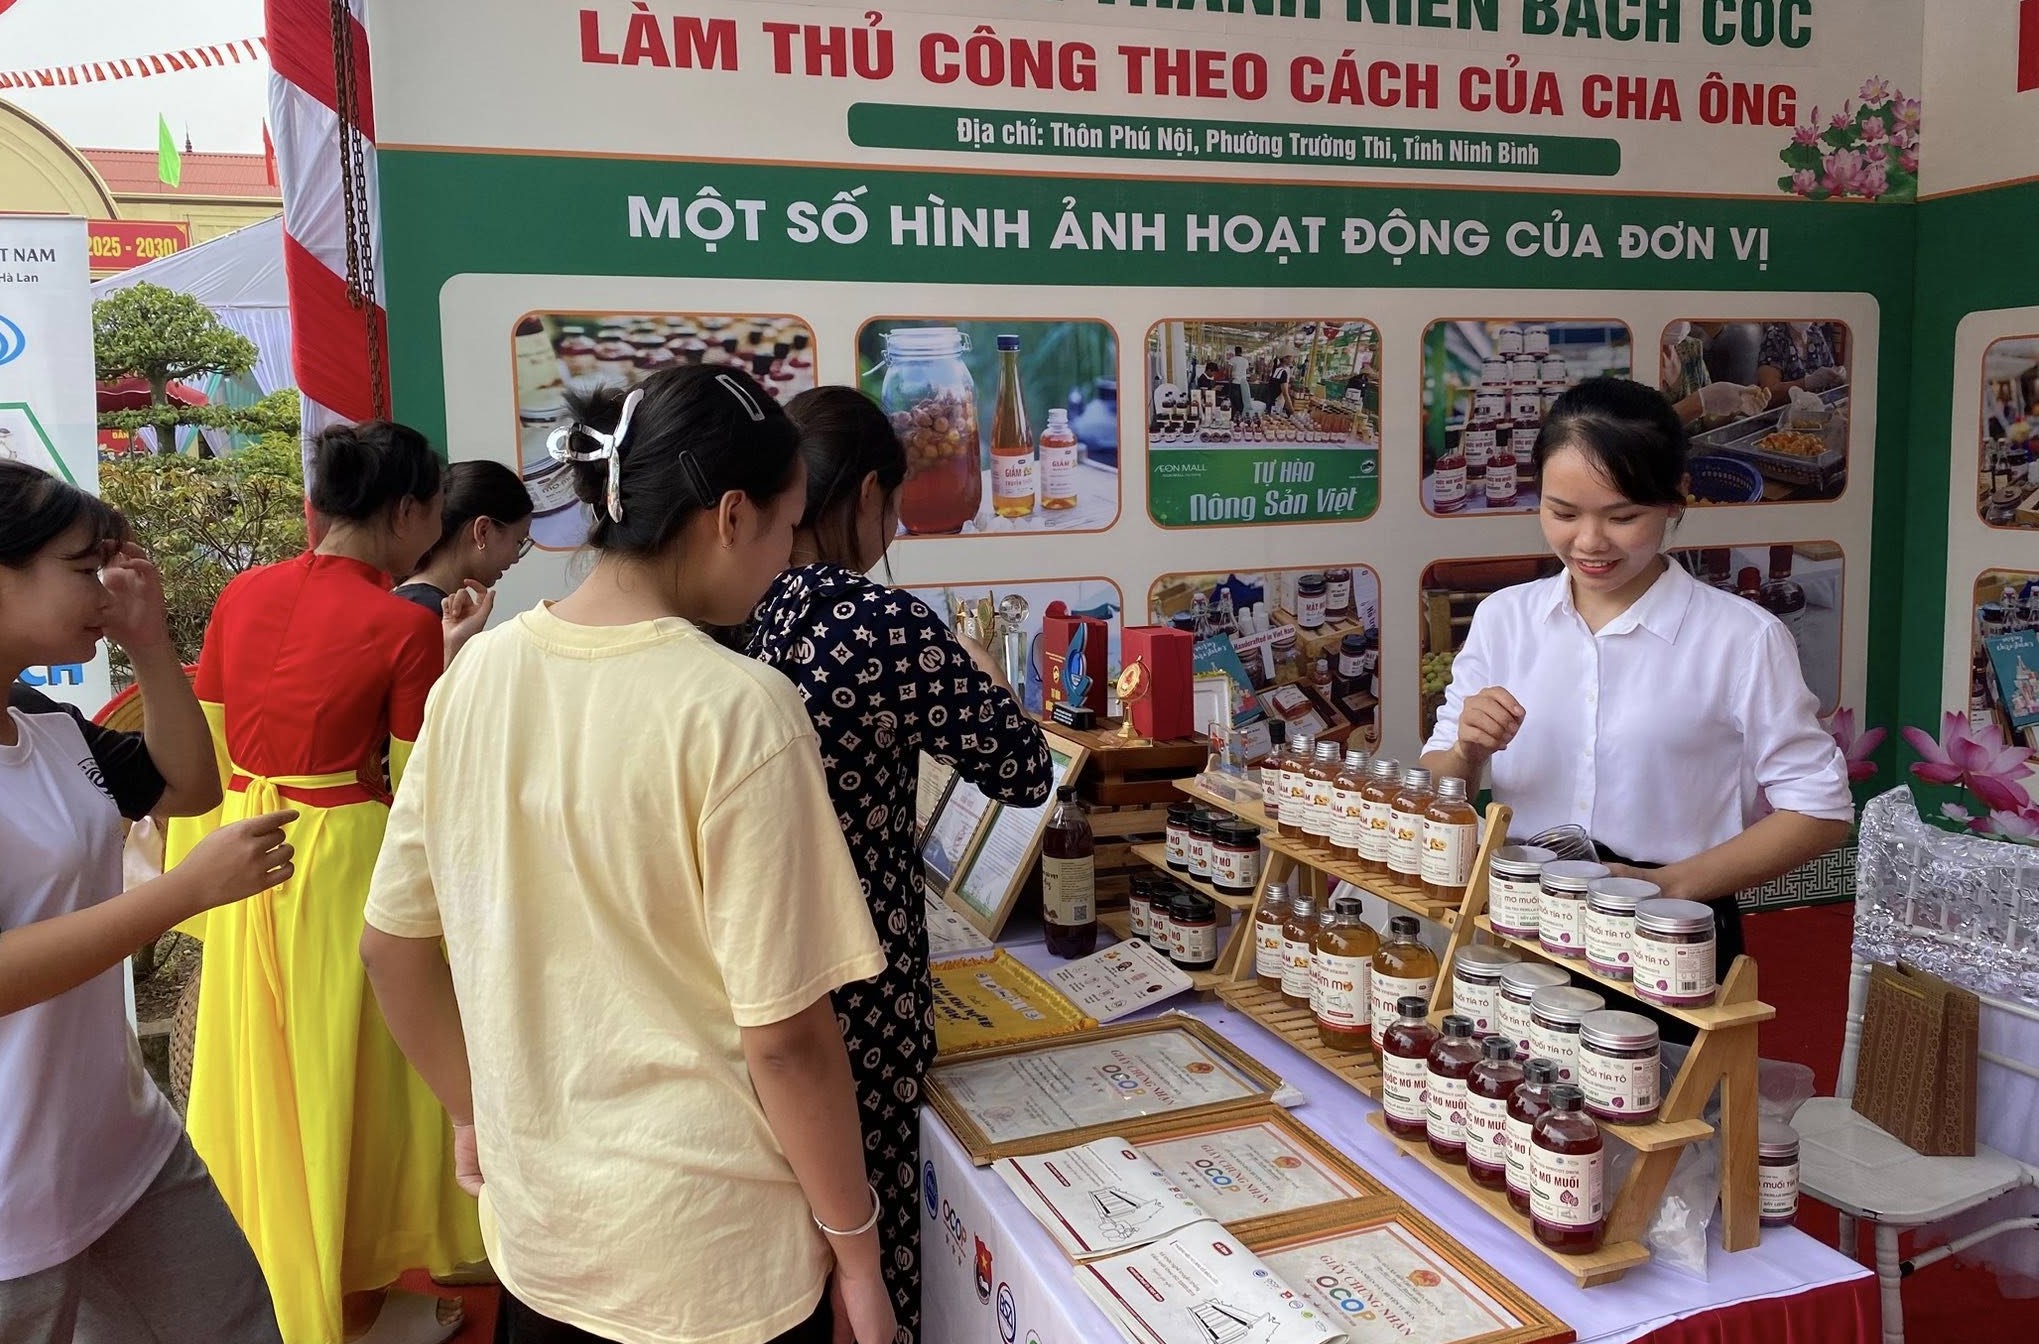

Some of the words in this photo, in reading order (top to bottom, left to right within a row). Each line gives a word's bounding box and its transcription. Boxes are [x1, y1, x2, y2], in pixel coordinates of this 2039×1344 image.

[579, 1, 738, 72] LÀM
[762, 10, 894, 80] THỦ
[920, 25, 1096, 92] CÔNG
[1118, 45, 1268, 101] THEO
[1290, 49, 1439, 110] CÁCH
[1459, 54, 1564, 116] CỦA
[1582, 74, 1682, 122] CHA
[1699, 72, 1796, 127] ÔNG
[957, 117, 994, 148] Địa
[1002, 118, 1043, 147] chỉ:
[1050, 122, 1103, 148] Thôn
[1110, 124, 1151, 151] Phú
[1157, 127, 1200, 157] Nội,
[1205, 129, 1283, 158] Phường
[1289, 132, 1356, 161] Trường
[1362, 135, 1397, 163] Thi,
[1403, 135, 1443, 162] Tỉnh
[1449, 139, 1492, 164] Ninh
[1498, 142, 1539, 166] Bình
[627, 185, 766, 253] MỘT
[786, 185, 868, 245] SỐ
[890, 193, 1029, 249] HÌNH
[1050, 196, 1165, 252] ẢNH
[1186, 214, 1326, 265] HOẠT
[1342, 208, 1490, 266] ĐỘNG
[1505, 209, 1604, 259] CỦA
[1618, 220, 1714, 261] ĐƠN
[1729, 227, 1769, 271] VỊ
[14, 248, 56, 262] NAM
[88, 236, 121, 256] 2025
[17, 273, 39, 283] Lan
[1182, 463, 1208, 472] MALL
[1253, 459, 1276, 487] TỰ
[1279, 457, 1315, 483] HÀO
[1190, 493, 1256, 522] Nông
[1264, 488, 1308, 516] Sản
[1316, 486, 1358, 516] Việt
[1620, 930, 1632, 939] TÔ
[1658, 957, 1670, 967] TÔ
[1562, 1046, 1574, 1056] TÔ
[1102, 1064, 1146, 1095] OCOP
[1615, 1074, 1627, 1083] TÔ
[1195, 1159, 1241, 1192] OCOP
[1554, 1175, 1579, 1188] MUỐI
[943, 1199, 967, 1247] OCOP
[1316, 1275, 1377, 1321] OCOP
